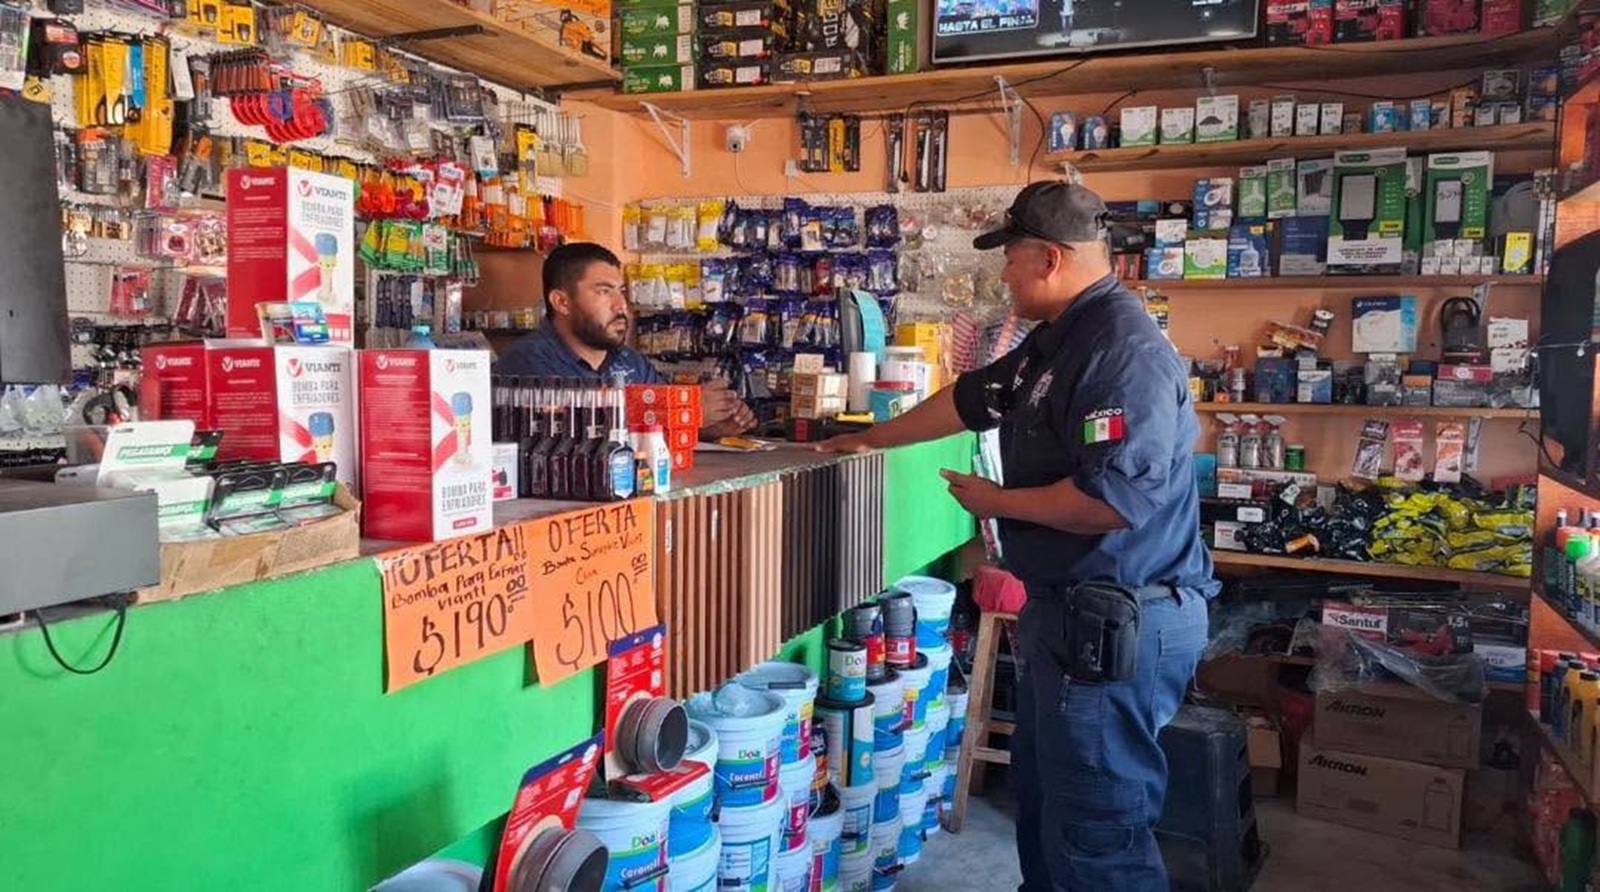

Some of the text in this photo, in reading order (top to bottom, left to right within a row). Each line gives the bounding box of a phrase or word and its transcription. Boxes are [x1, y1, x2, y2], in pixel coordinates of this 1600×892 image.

[940, 20, 978, 33] HASTA
[981, 18, 996, 29] EL
[315, 186, 347, 201] VIANTI
[305, 362, 342, 373] VIANTI
[548, 503, 637, 553] OFERTA
[1325, 700, 1387, 718] AKRON
[1308, 755, 1369, 776] AKRON
